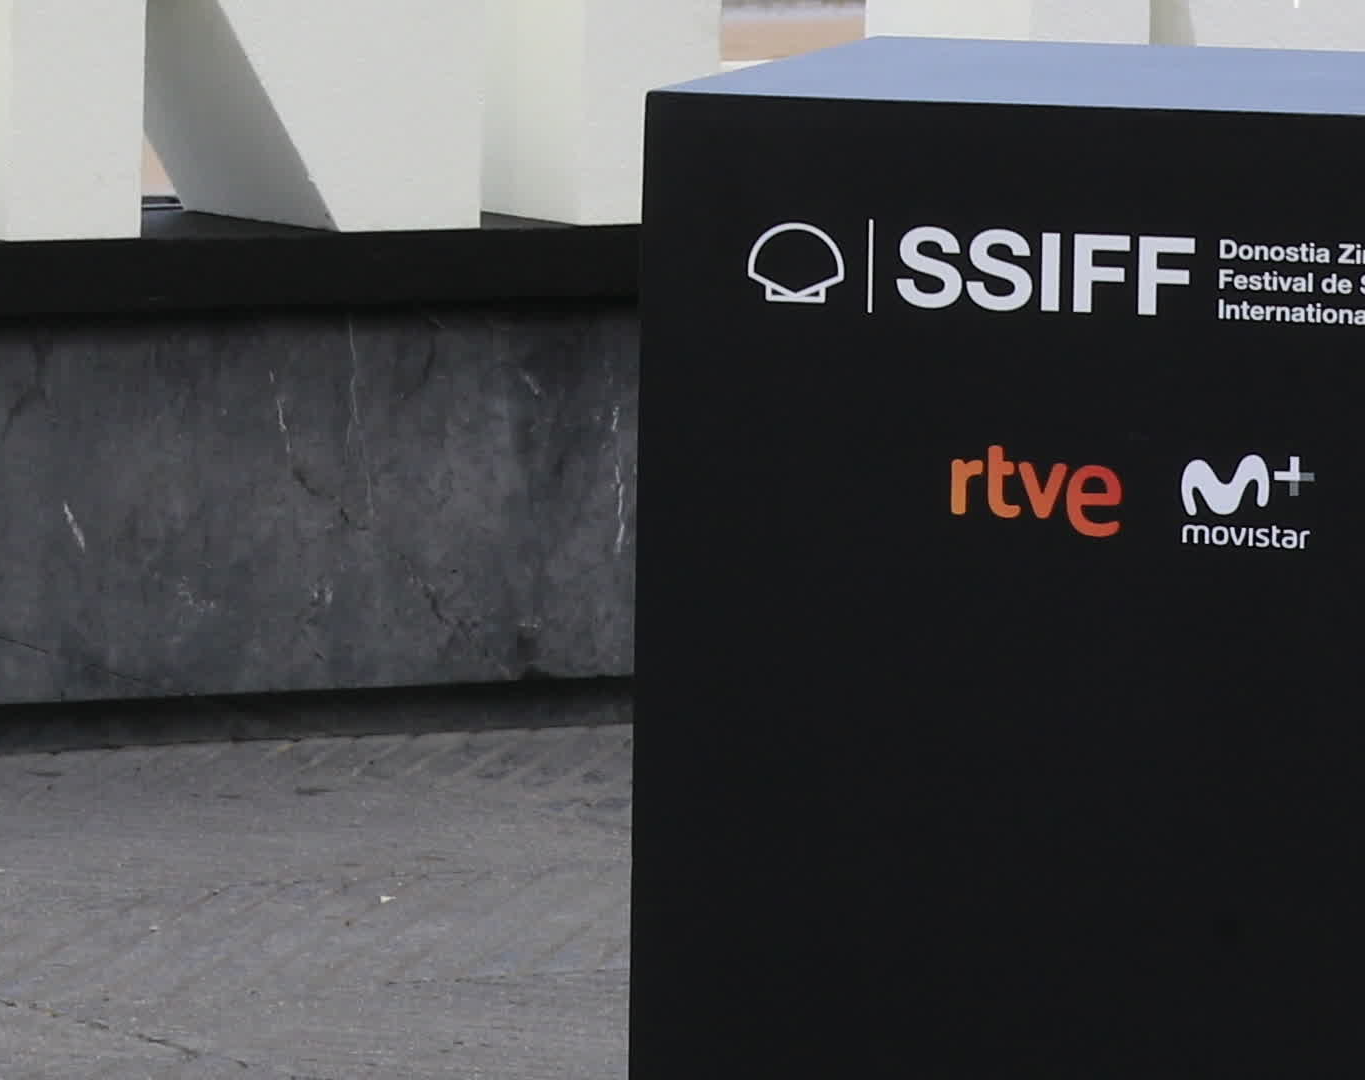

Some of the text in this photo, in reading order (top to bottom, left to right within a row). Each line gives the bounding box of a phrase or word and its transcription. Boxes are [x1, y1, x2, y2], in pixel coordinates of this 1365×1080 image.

[1219, 238, 1365, 265] Donostia Zi
[896, 225, 1197, 317] SSIFF
[1218, 268, 1314, 293] Festival
[1321, 273, 1353, 295] de
[1218, 297, 1365, 326] Internationa
[950, 444, 1123, 538] rtve
[1180, 523, 1311, 550] movistar
